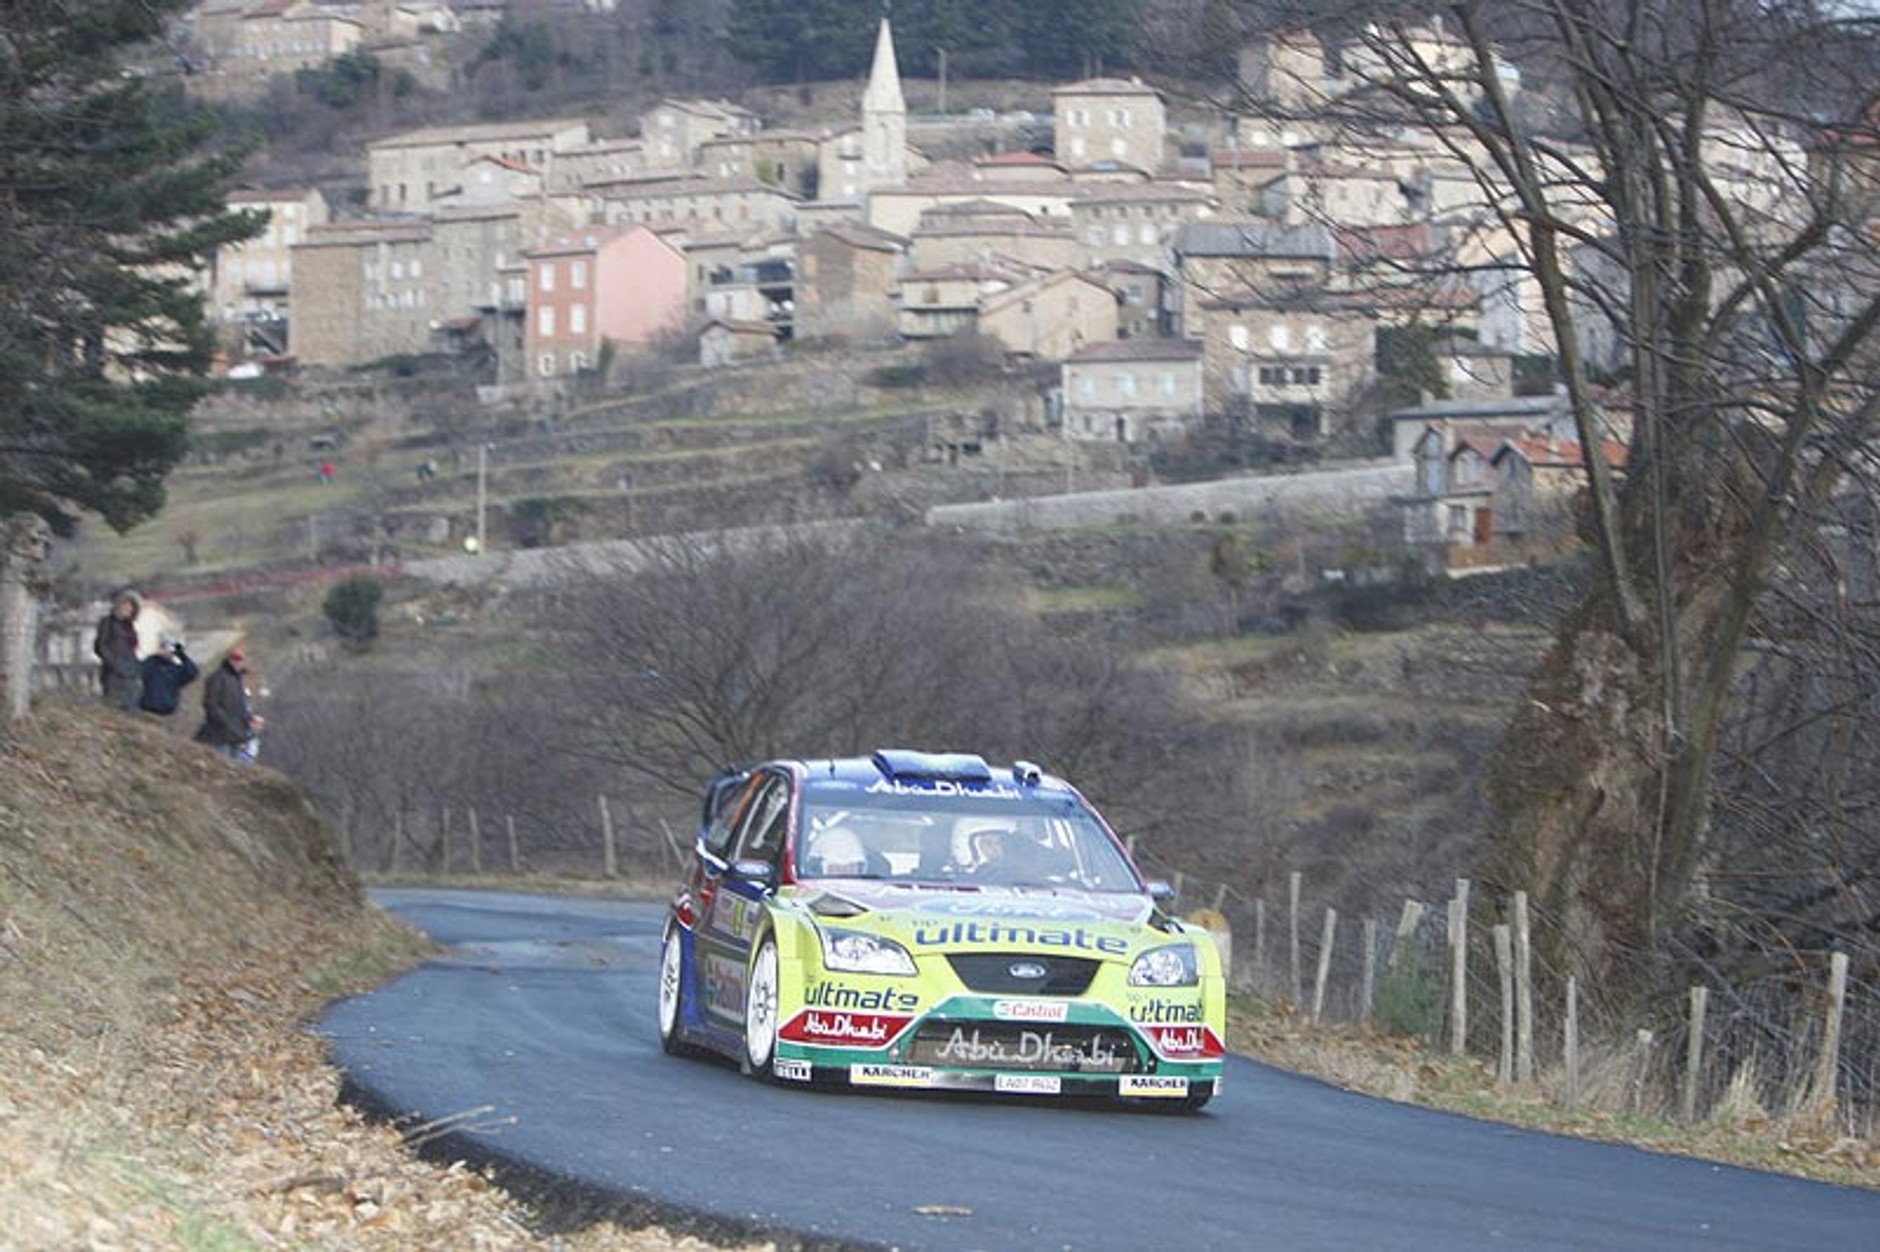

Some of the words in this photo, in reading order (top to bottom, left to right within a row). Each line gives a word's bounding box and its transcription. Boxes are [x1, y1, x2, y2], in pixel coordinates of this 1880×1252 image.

[915, 922, 1130, 955] ultimate
[803, 1012, 831, 1035] Abu
[833, 1013, 888, 1040] Dhabi
[1011, 1003, 1064, 1019] Castrol
[937, 1027, 1007, 1062] Abu
[1009, 1031, 1116, 1066] Dhabi
